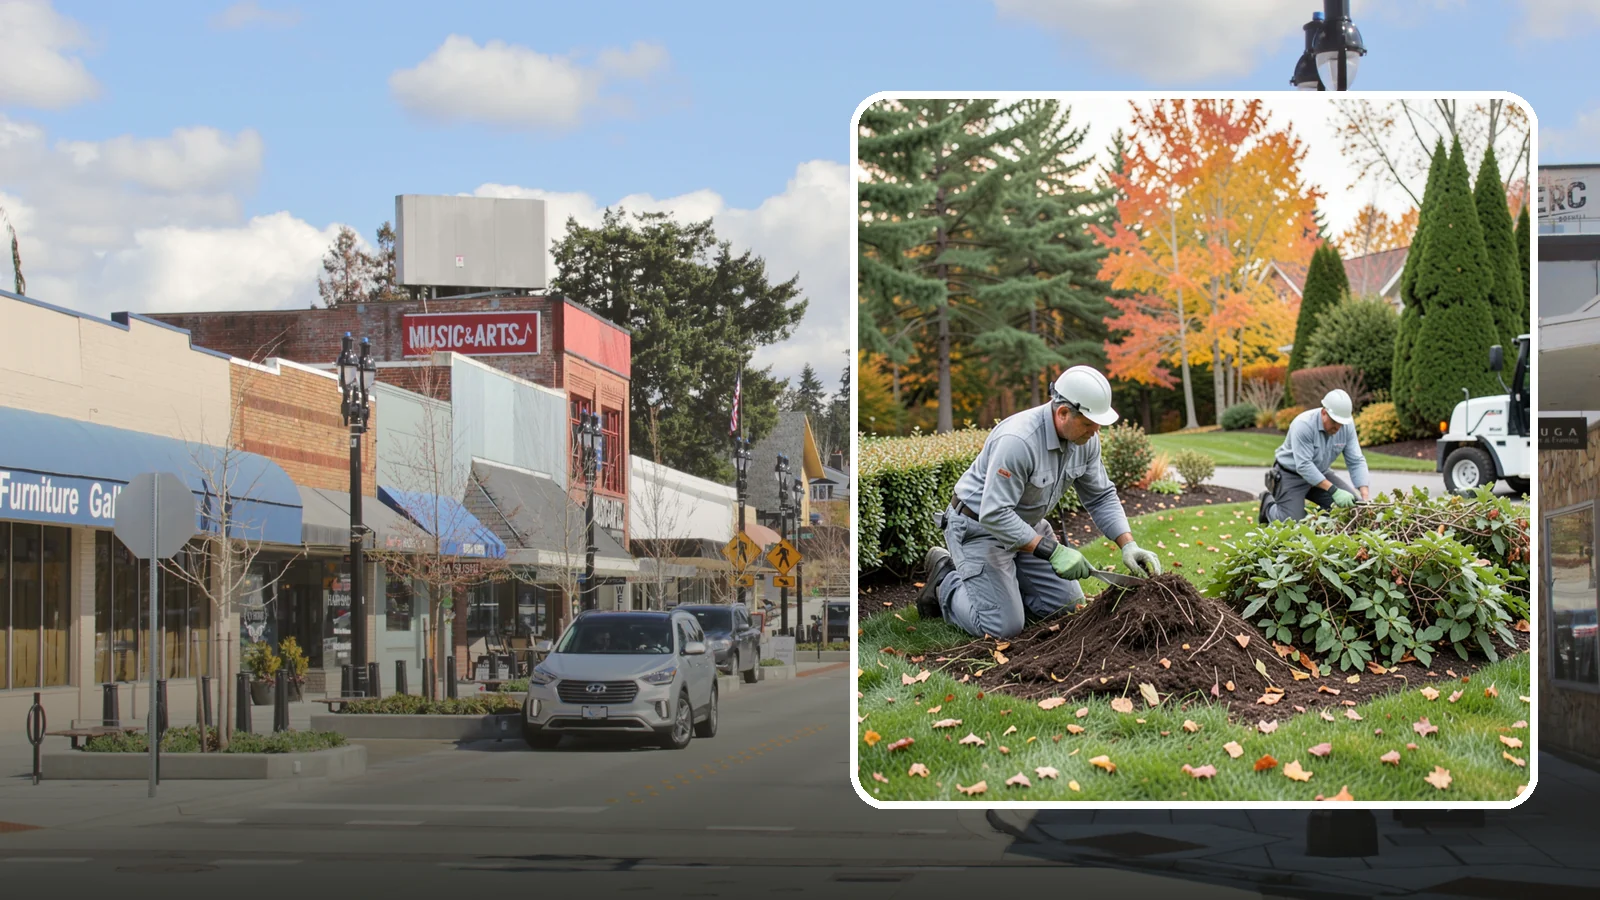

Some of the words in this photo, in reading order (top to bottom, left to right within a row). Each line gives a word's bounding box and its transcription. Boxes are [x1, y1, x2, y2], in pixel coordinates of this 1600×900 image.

[409, 323, 519, 348] MUSIC&ARTS
[1540, 427, 1577, 436] UGA
[0, 471, 79, 515] Furniture
[89, 482, 122, 519] Gal
[453, 562, 479, 575] SUSHI
